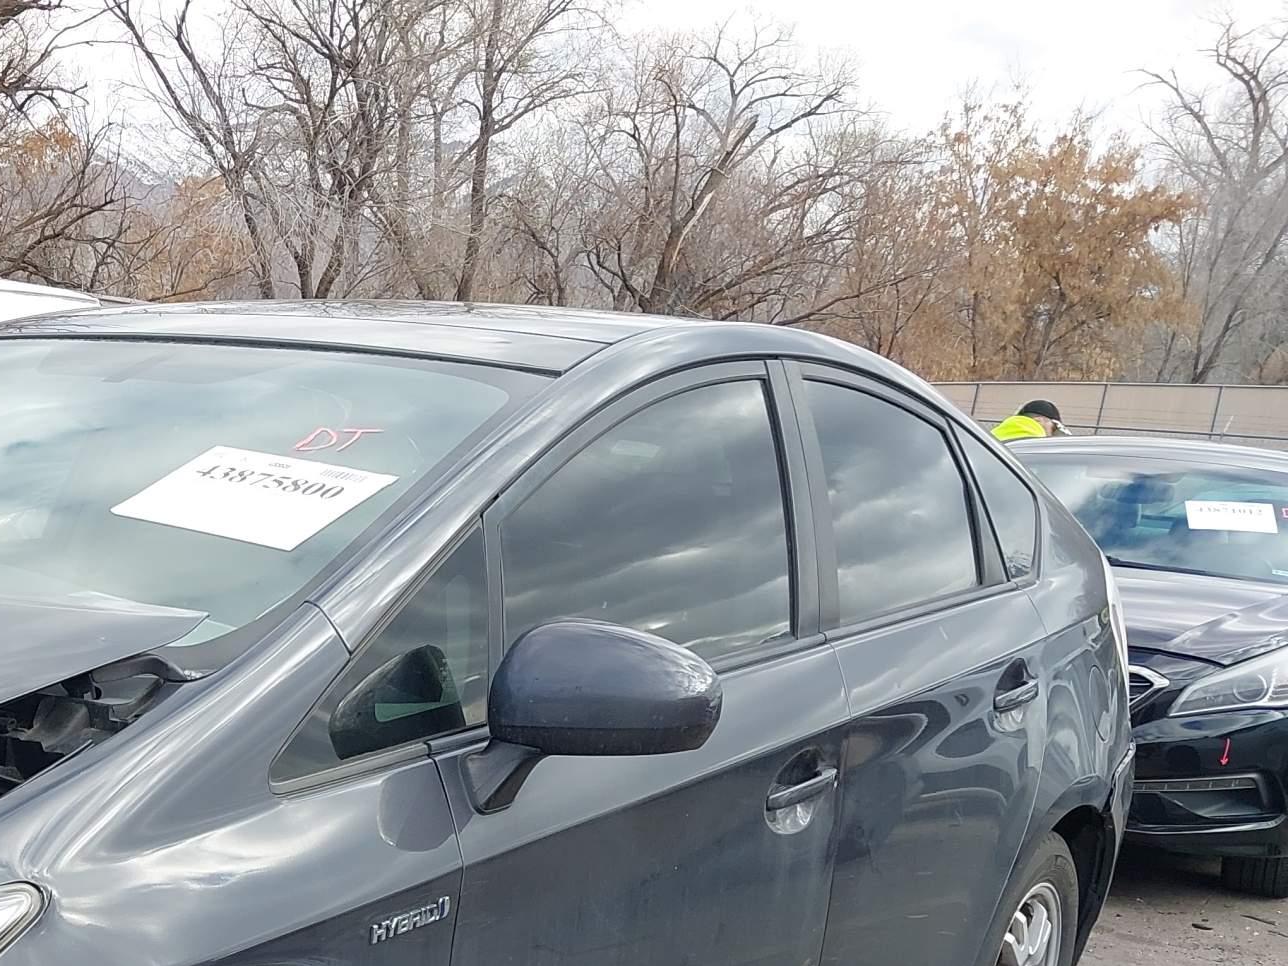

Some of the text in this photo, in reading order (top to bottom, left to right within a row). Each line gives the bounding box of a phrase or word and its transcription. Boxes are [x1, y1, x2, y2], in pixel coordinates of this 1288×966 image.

[295, 427, 385, 452] DT
[196, 464, 345, 499] 43875800
[370, 896, 451, 945] HYBRID
